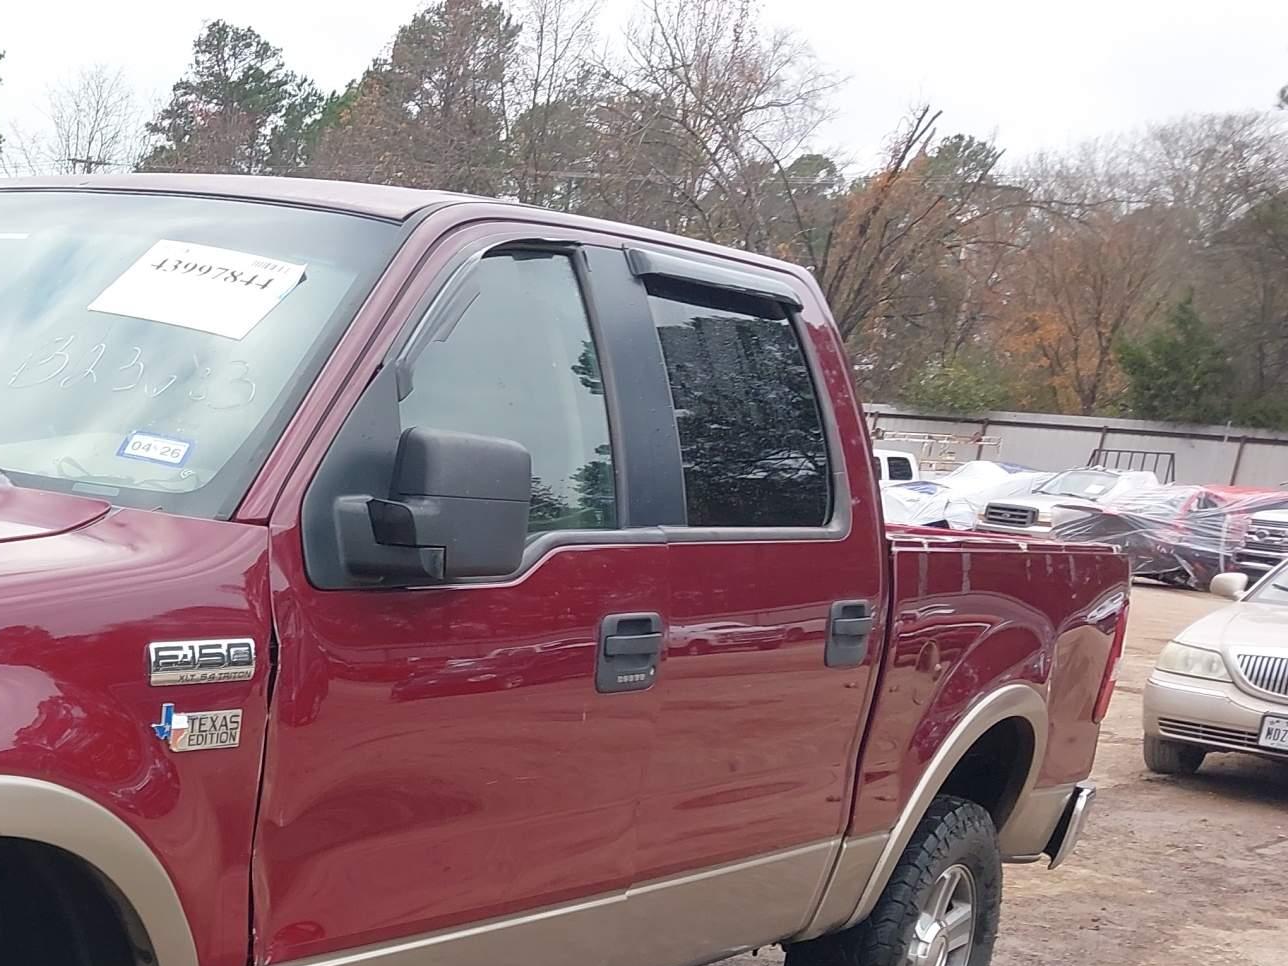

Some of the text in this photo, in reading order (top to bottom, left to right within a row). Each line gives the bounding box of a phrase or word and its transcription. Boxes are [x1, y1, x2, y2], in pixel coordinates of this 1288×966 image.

[150, 257, 275, 290] 43997844
[177, 674, 196, 683] XLT
[217, 670, 252, 681] TRITON
[187, 714, 241, 734] TEXAS
[187, 730, 237, 747] EDITION
